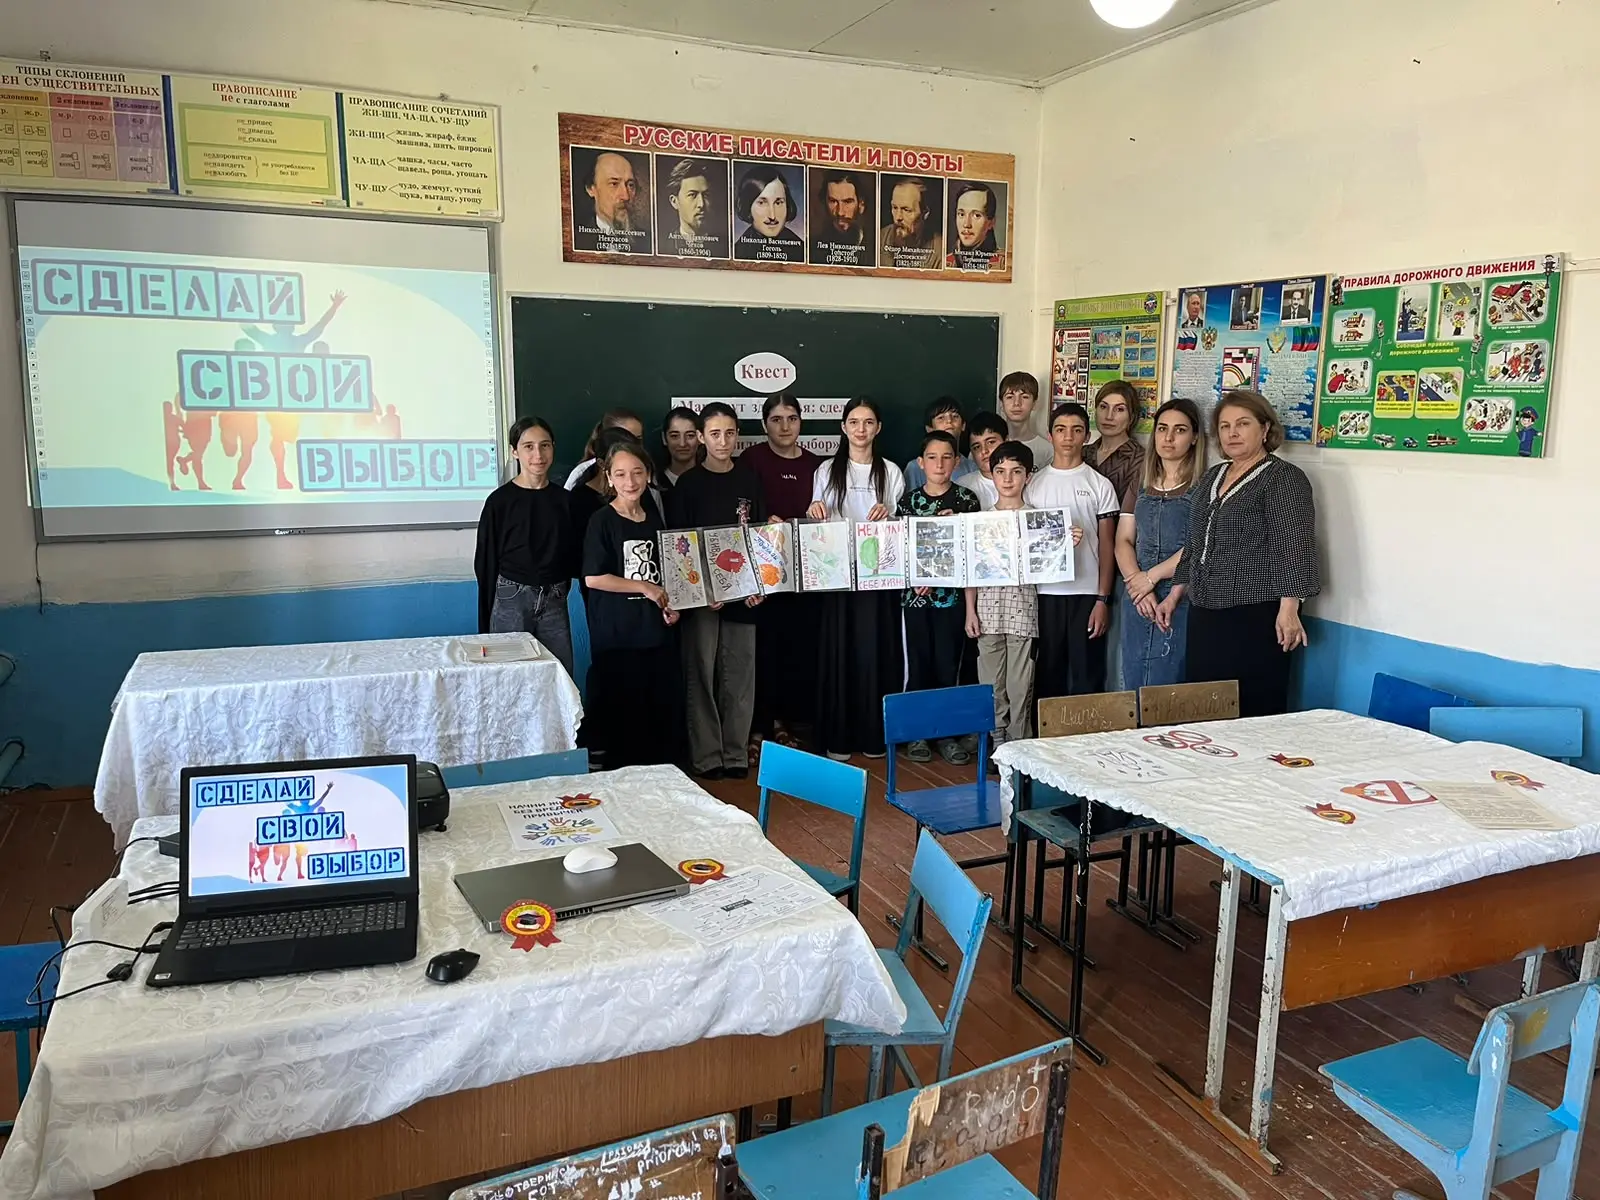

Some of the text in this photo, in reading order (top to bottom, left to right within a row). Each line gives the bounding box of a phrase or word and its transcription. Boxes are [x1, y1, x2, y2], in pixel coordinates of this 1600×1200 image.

[16, 65, 126, 83] ТИПЫ СКЛОНЕНИЙ
[25, 76, 160, 97] СУЩЕСТВИТЕЛЬНЫХ
[212, 82, 298, 99] ПРАВОПИСАНИЕ
[221, 93, 233, 102] не
[243, 98, 290, 108] глаголами
[349, 97, 487, 118] ПРАВОПИСАНИЕ СОЧЕТАНИЙ
[440, 116, 471, 127] ЧУ-ЩУ
[349, 129, 385, 139] ЖИ-ШИ
[457, 144, 493, 154] широкий
[624, 124, 964, 173] РУССКИЕ ПИСАТЕЛИ И ПОЭТЫ
[352, 156, 387, 167] ЧА-ЩА
[456, 170, 488, 179] угощать
[355, 183, 388, 193] ЧУ-ЩУ
[454, 186, 482, 194] чуткий
[459, 195, 483, 204] угощу
[598, 234, 628, 243] Некрасов
[609, 228, 646, 237] Алексеевич
[768, 238, 801, 246] Васильевич
[829, 242, 866, 252] Николаевич
[756, 252, 788, 261] (1809-1852)
[1344, 260, 1535, 288] ПРАВИЛА ДОРОЖНОГО ДВИЖЕНИЯ
[42, 267, 295, 316] СДЕЛАЙ
[741, 364, 790, 379] Квест
[190, 358, 363, 404] СВОЙ
[306, 446, 490, 484] ВЫБОР
[857, 523, 872, 537] НЕ
[713, 568, 732, 591] СЕБЯ
[859, 579, 879, 590] СЕБЕ
[200, 778, 311, 803] СДЕЛАЙ
[508, 802, 546, 810] НАЧНИ
[261, 814, 340, 840] СВОЙ
[311, 851, 401, 876] ВЫБОР
